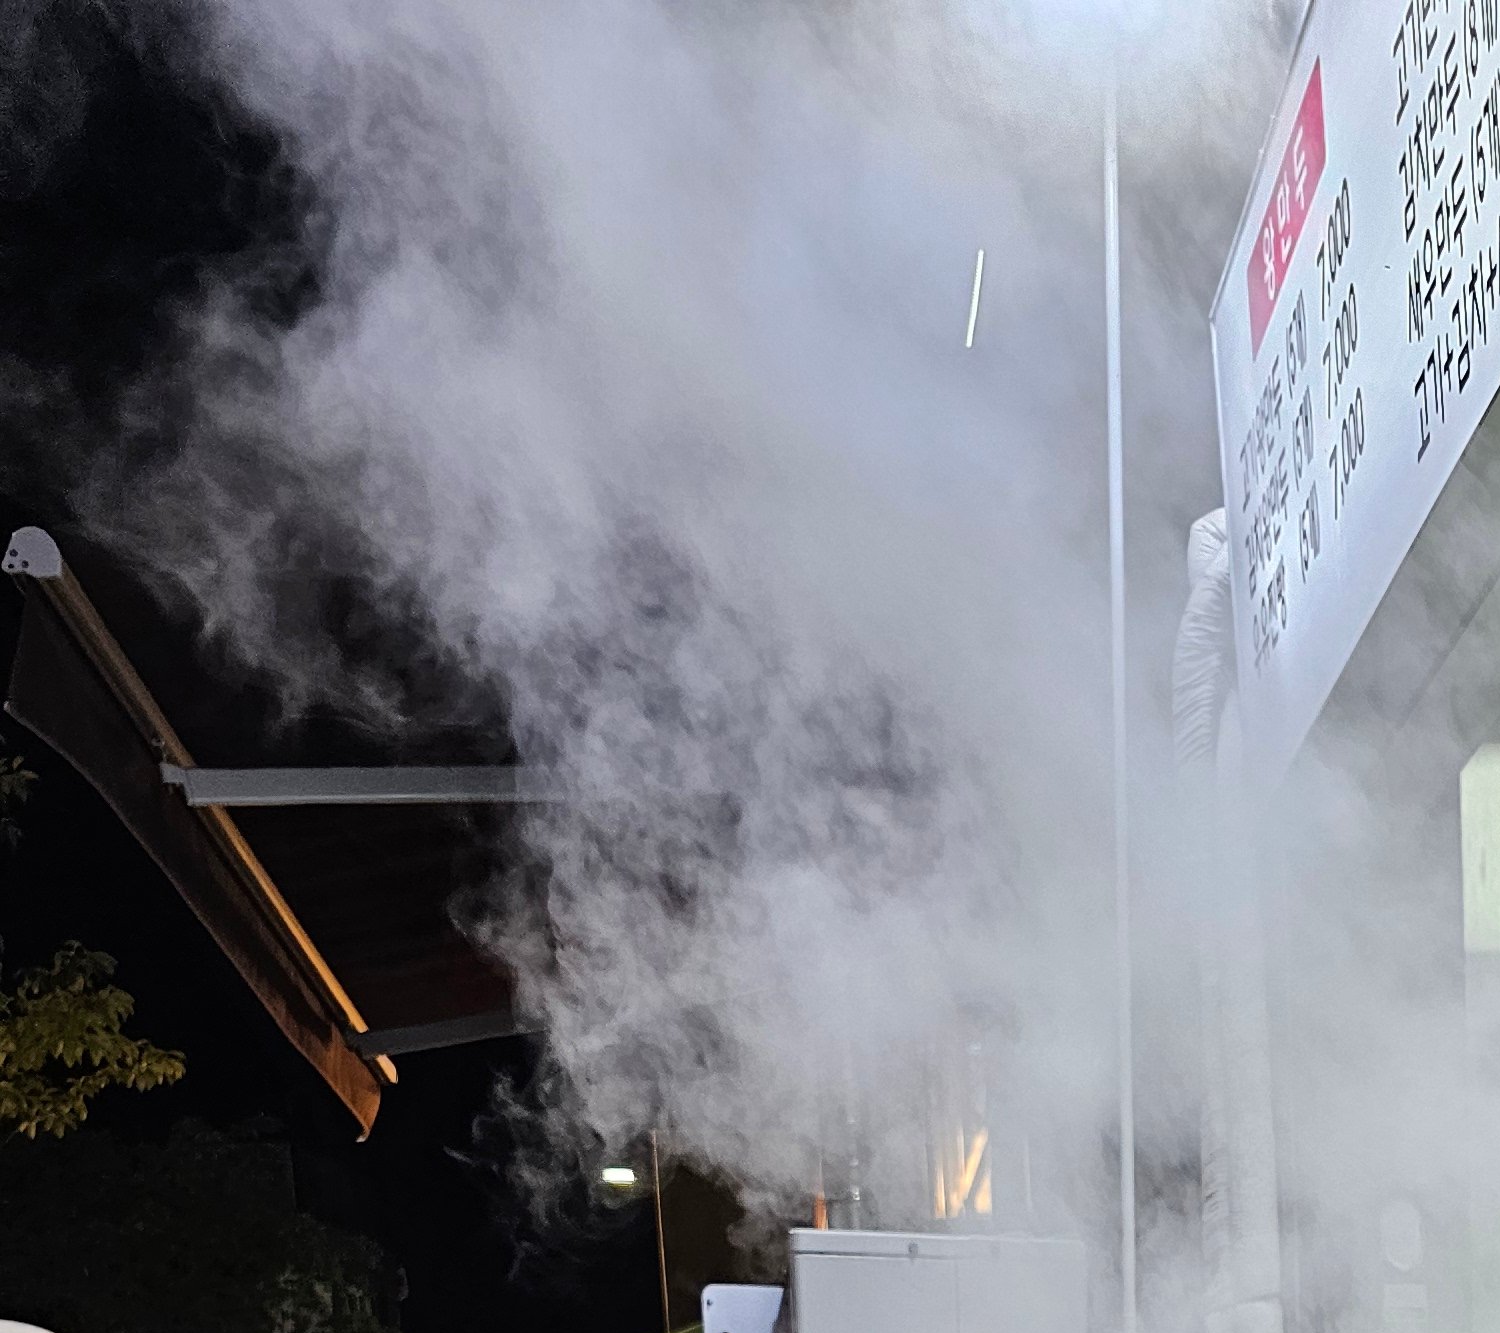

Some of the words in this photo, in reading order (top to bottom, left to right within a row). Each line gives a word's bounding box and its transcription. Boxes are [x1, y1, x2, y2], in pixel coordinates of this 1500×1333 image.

[1392, 0, 1449, 126] 고기만
[1399, 30, 1460, 243] 김치만두
[1262, 125, 1308, 301] 왕만두
[1316, 177, 1351, 322] 7,000
[1408, 154, 1468, 344] 새우만두
[1322, 282, 1358, 420] 7,000
[1329, 386, 1365, 521] 7,000
